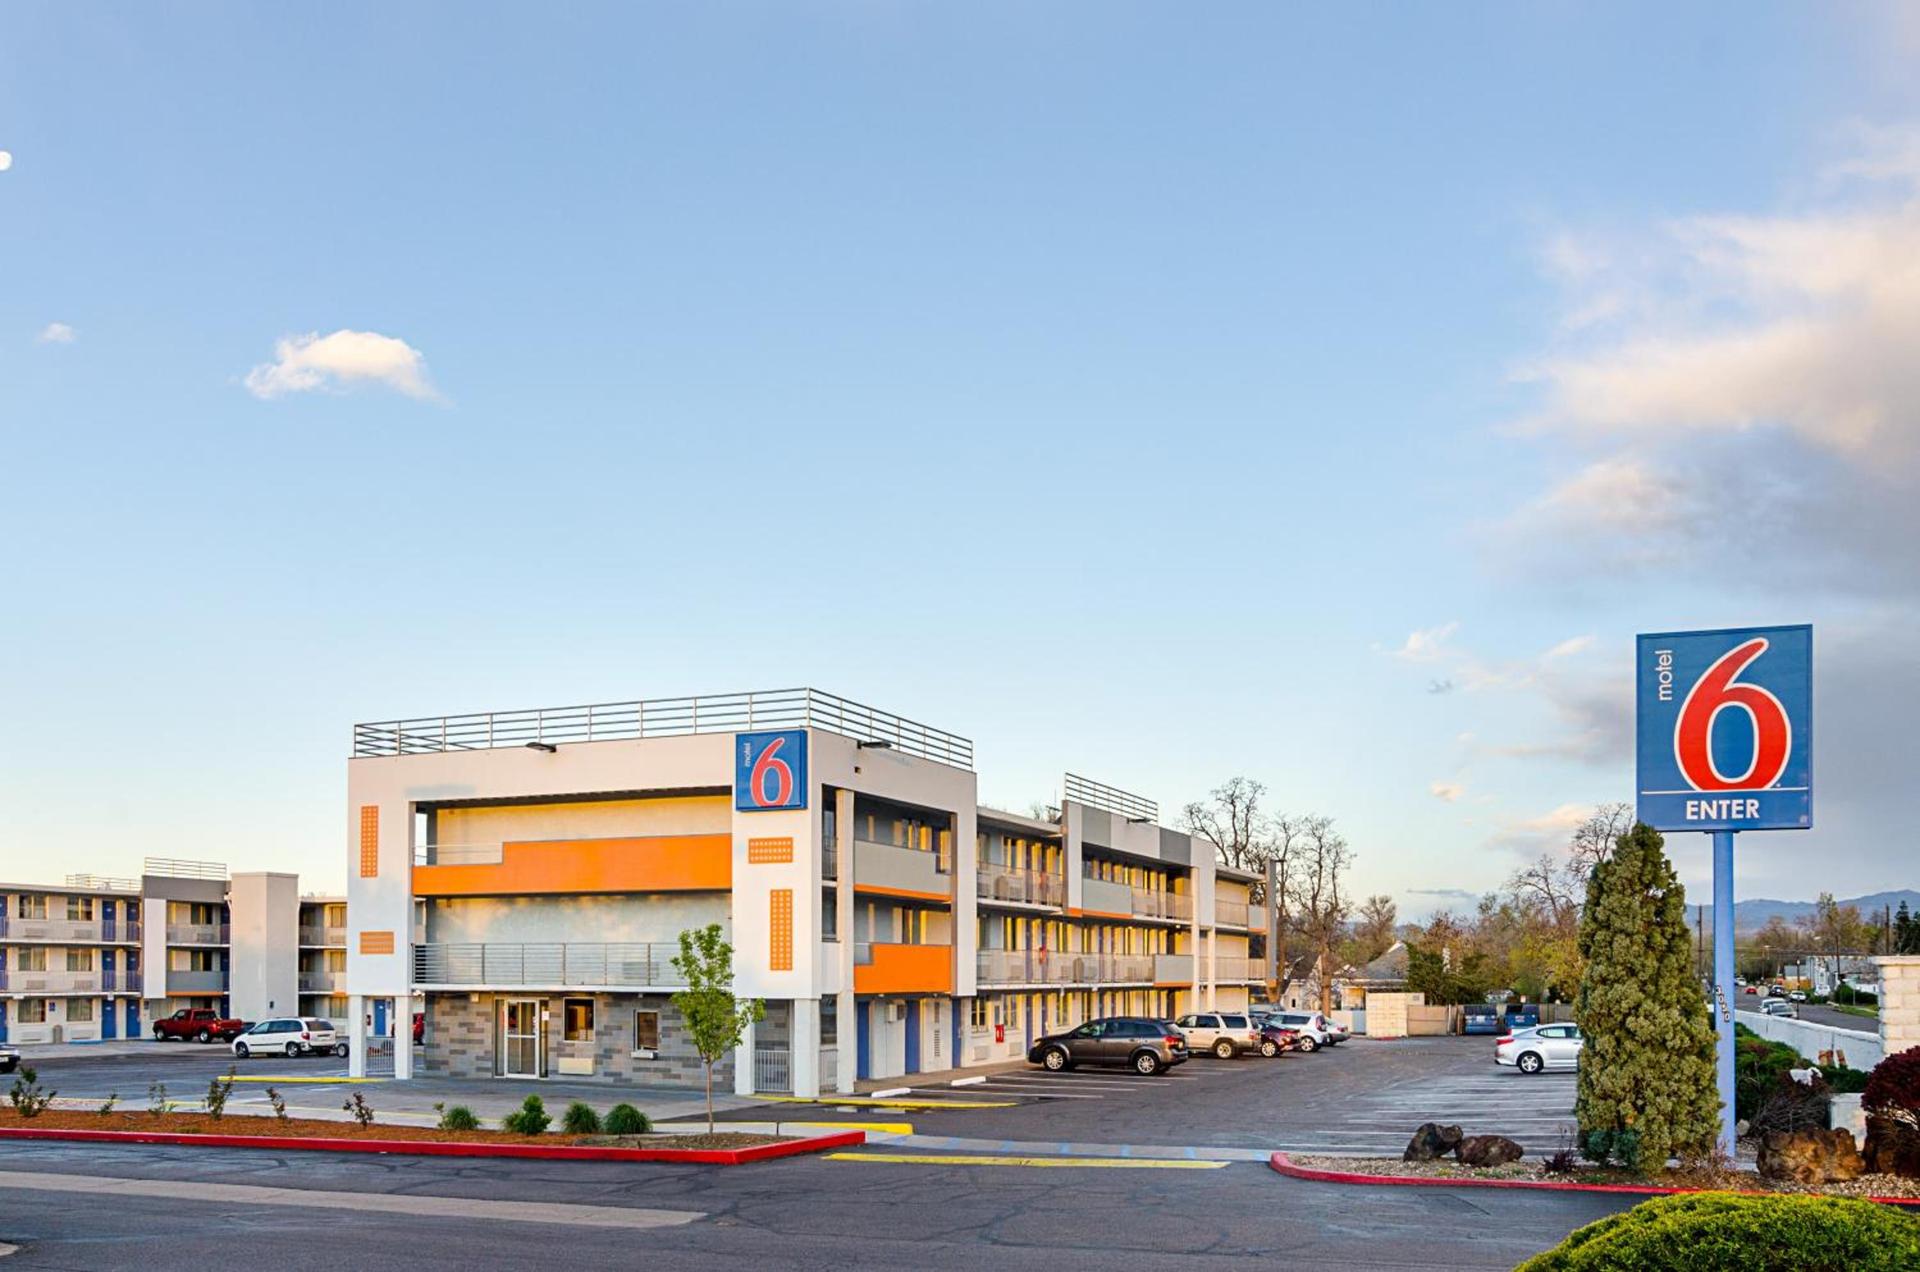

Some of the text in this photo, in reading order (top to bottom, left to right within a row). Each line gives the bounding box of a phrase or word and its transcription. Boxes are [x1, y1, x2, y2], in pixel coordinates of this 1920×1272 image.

[1655, 649, 1673, 701] motel
[1674, 636, 1792, 792] 6
[743, 742, 752, 768] motel
[750, 737, 794, 807] 6
[1685, 798, 1760, 820] ENTER
